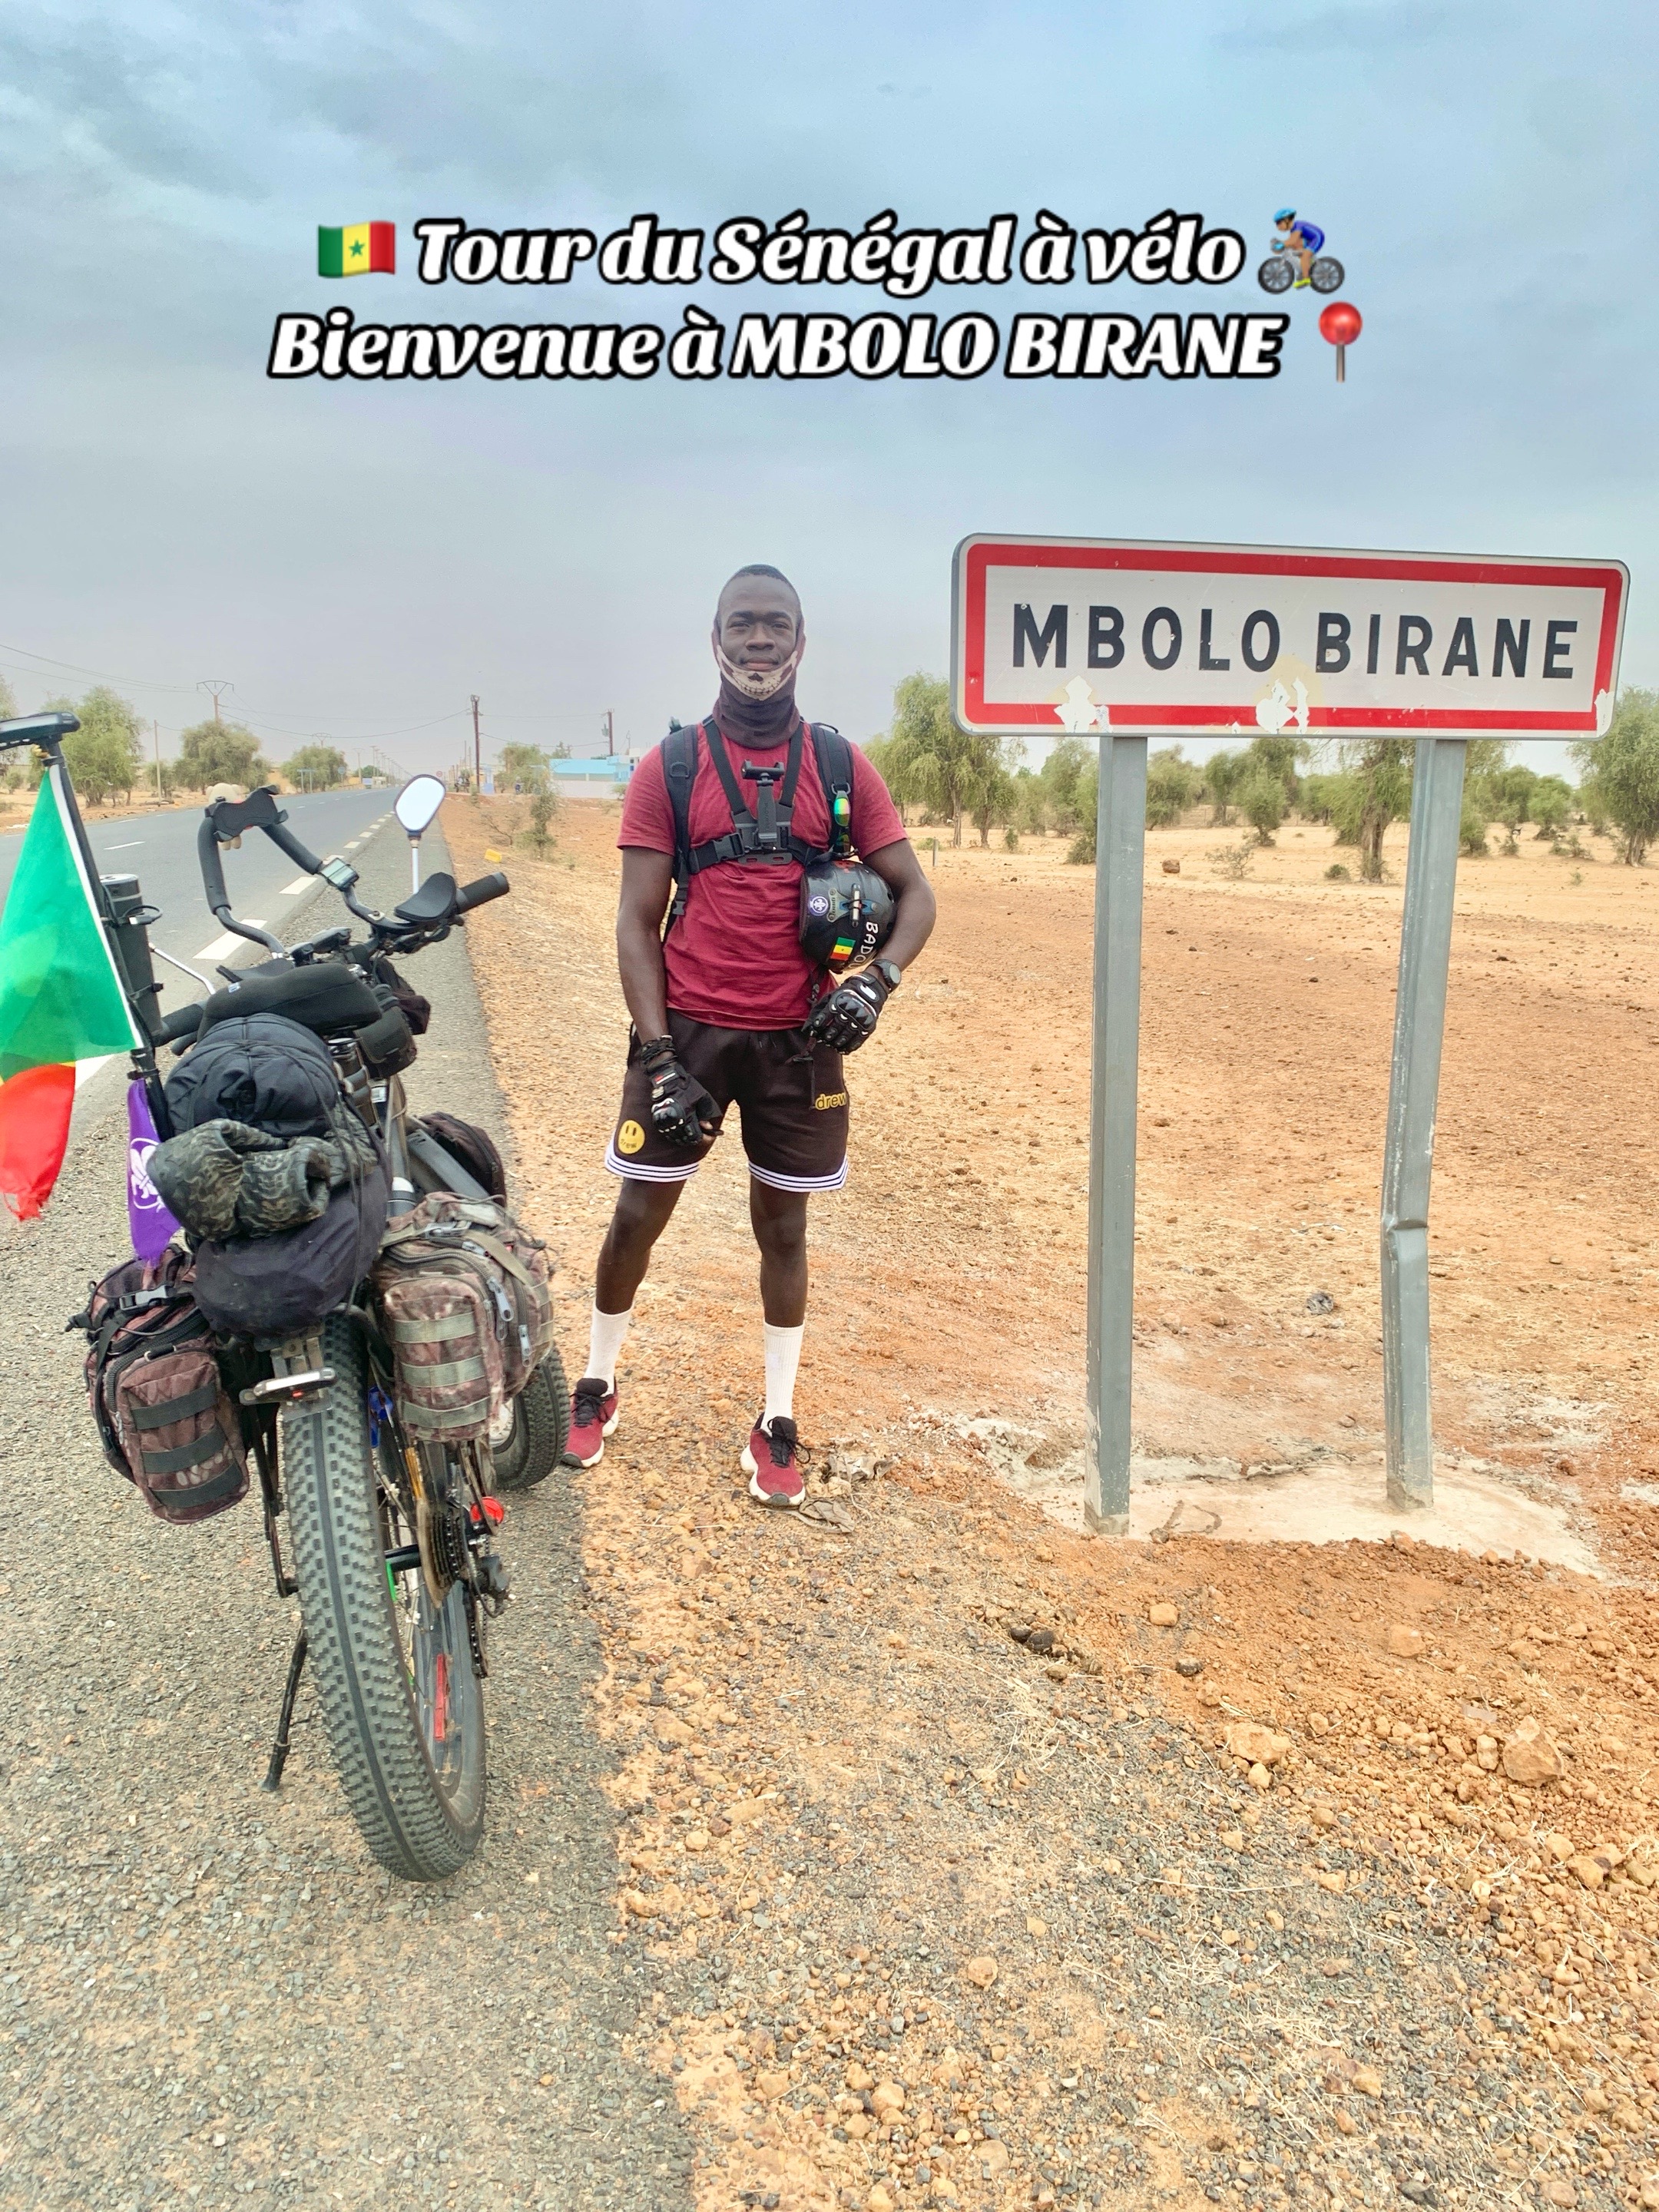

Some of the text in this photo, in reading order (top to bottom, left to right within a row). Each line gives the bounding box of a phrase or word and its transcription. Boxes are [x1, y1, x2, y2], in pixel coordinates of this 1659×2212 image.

[1012, 603, 1578, 680] MBOLO BIRANE
[815, 1092, 846, 1111] drew
